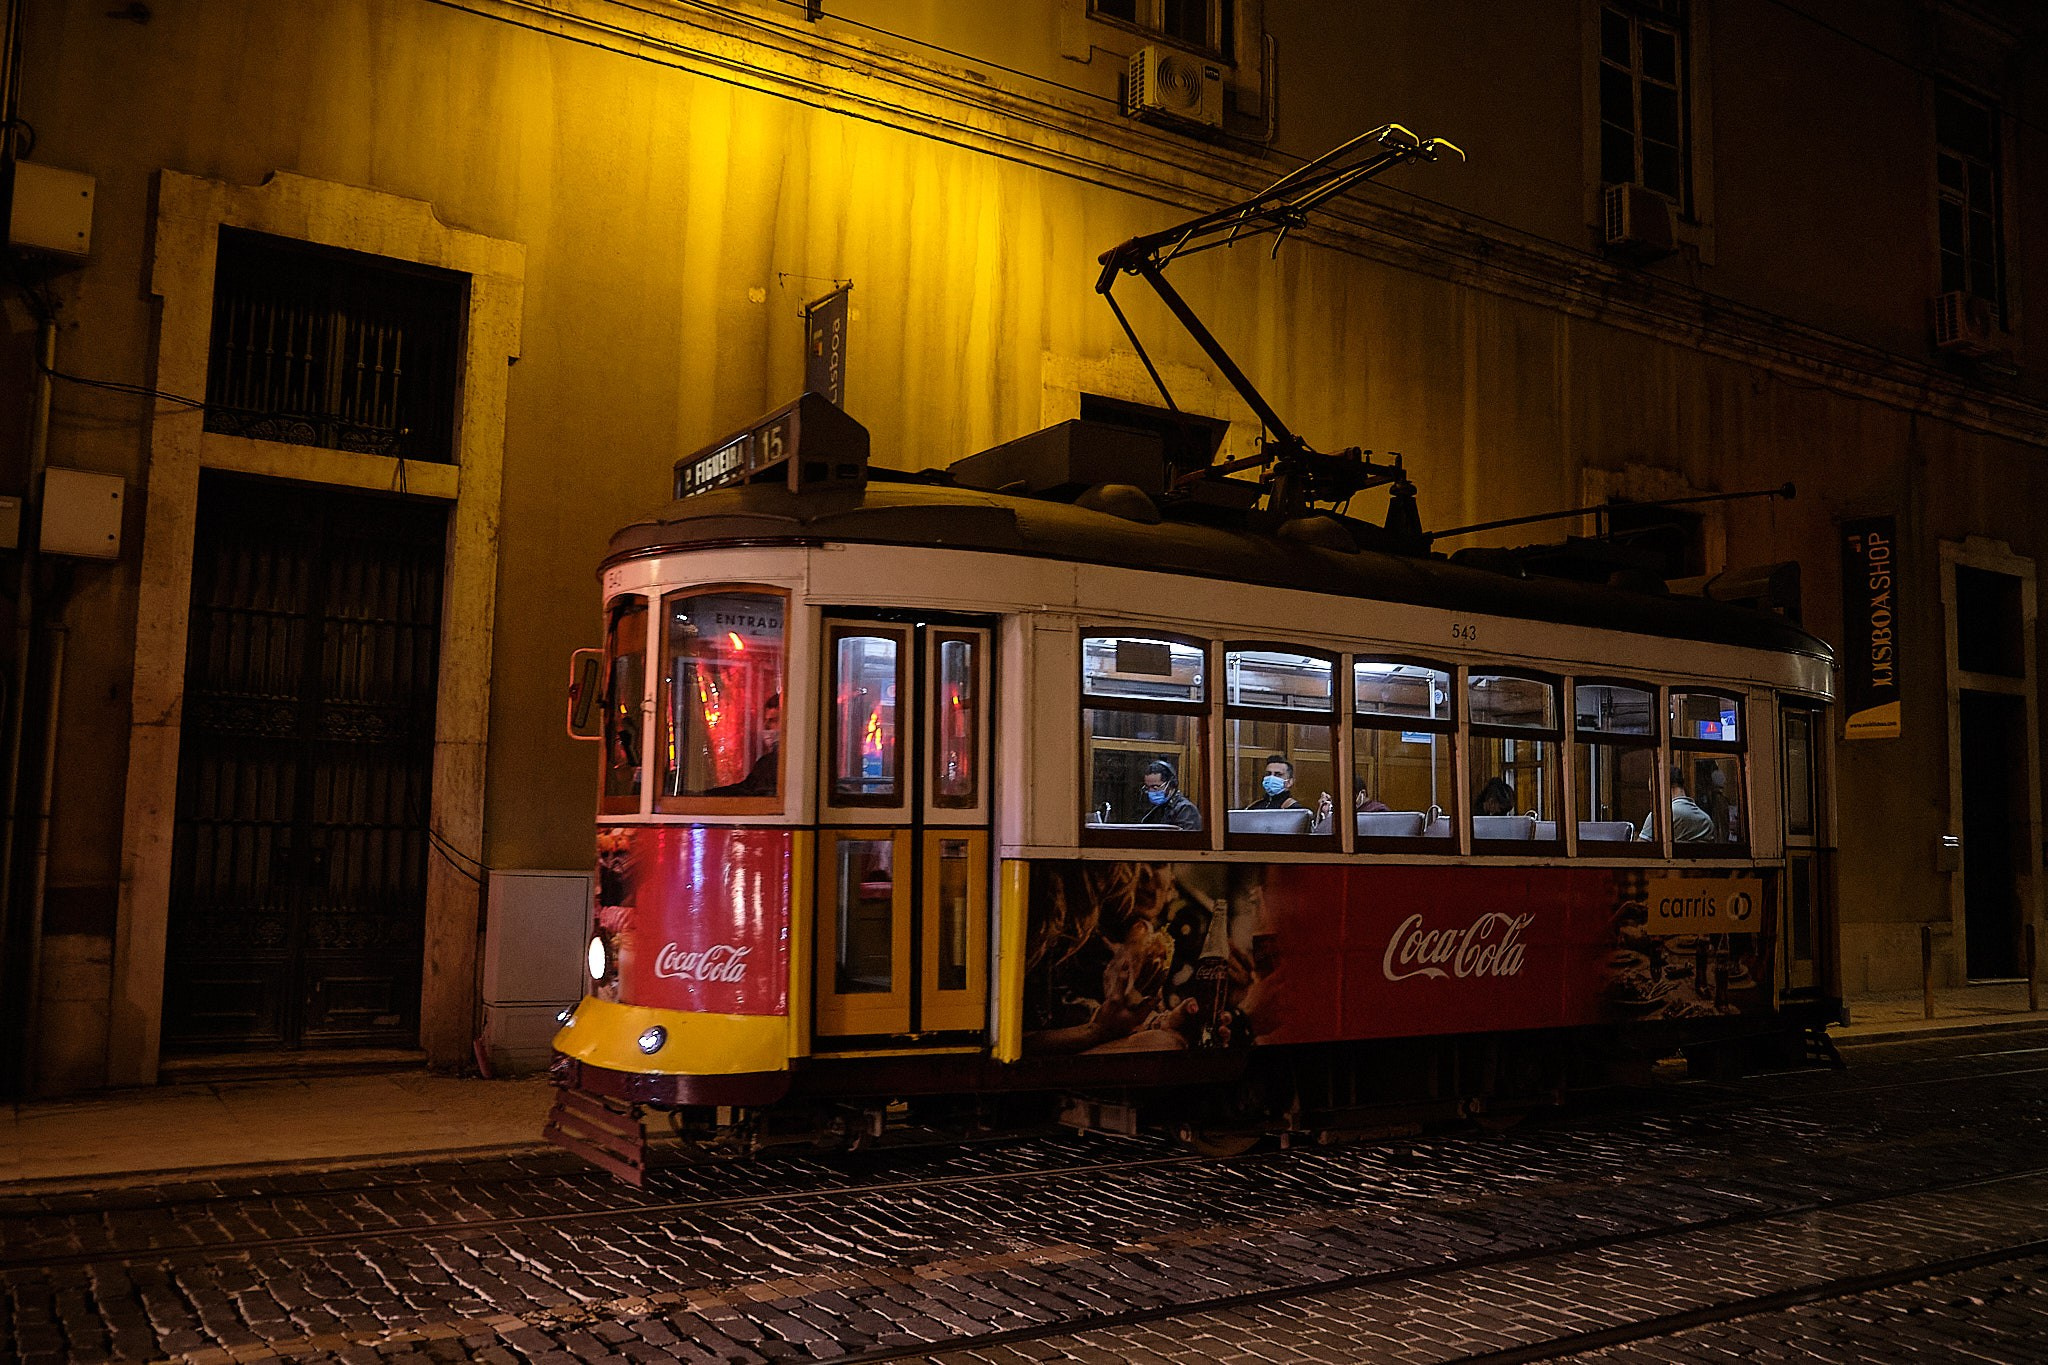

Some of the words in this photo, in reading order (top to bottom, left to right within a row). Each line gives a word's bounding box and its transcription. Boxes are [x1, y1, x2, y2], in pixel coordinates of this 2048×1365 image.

[763, 425, 783, 463] 15
[1452, 623, 1476, 641] 543
[1659, 889, 1716, 918] carris
[654, 942, 754, 983] Coca-Cola
[1383, 912, 1536, 982] Coca-Cola
